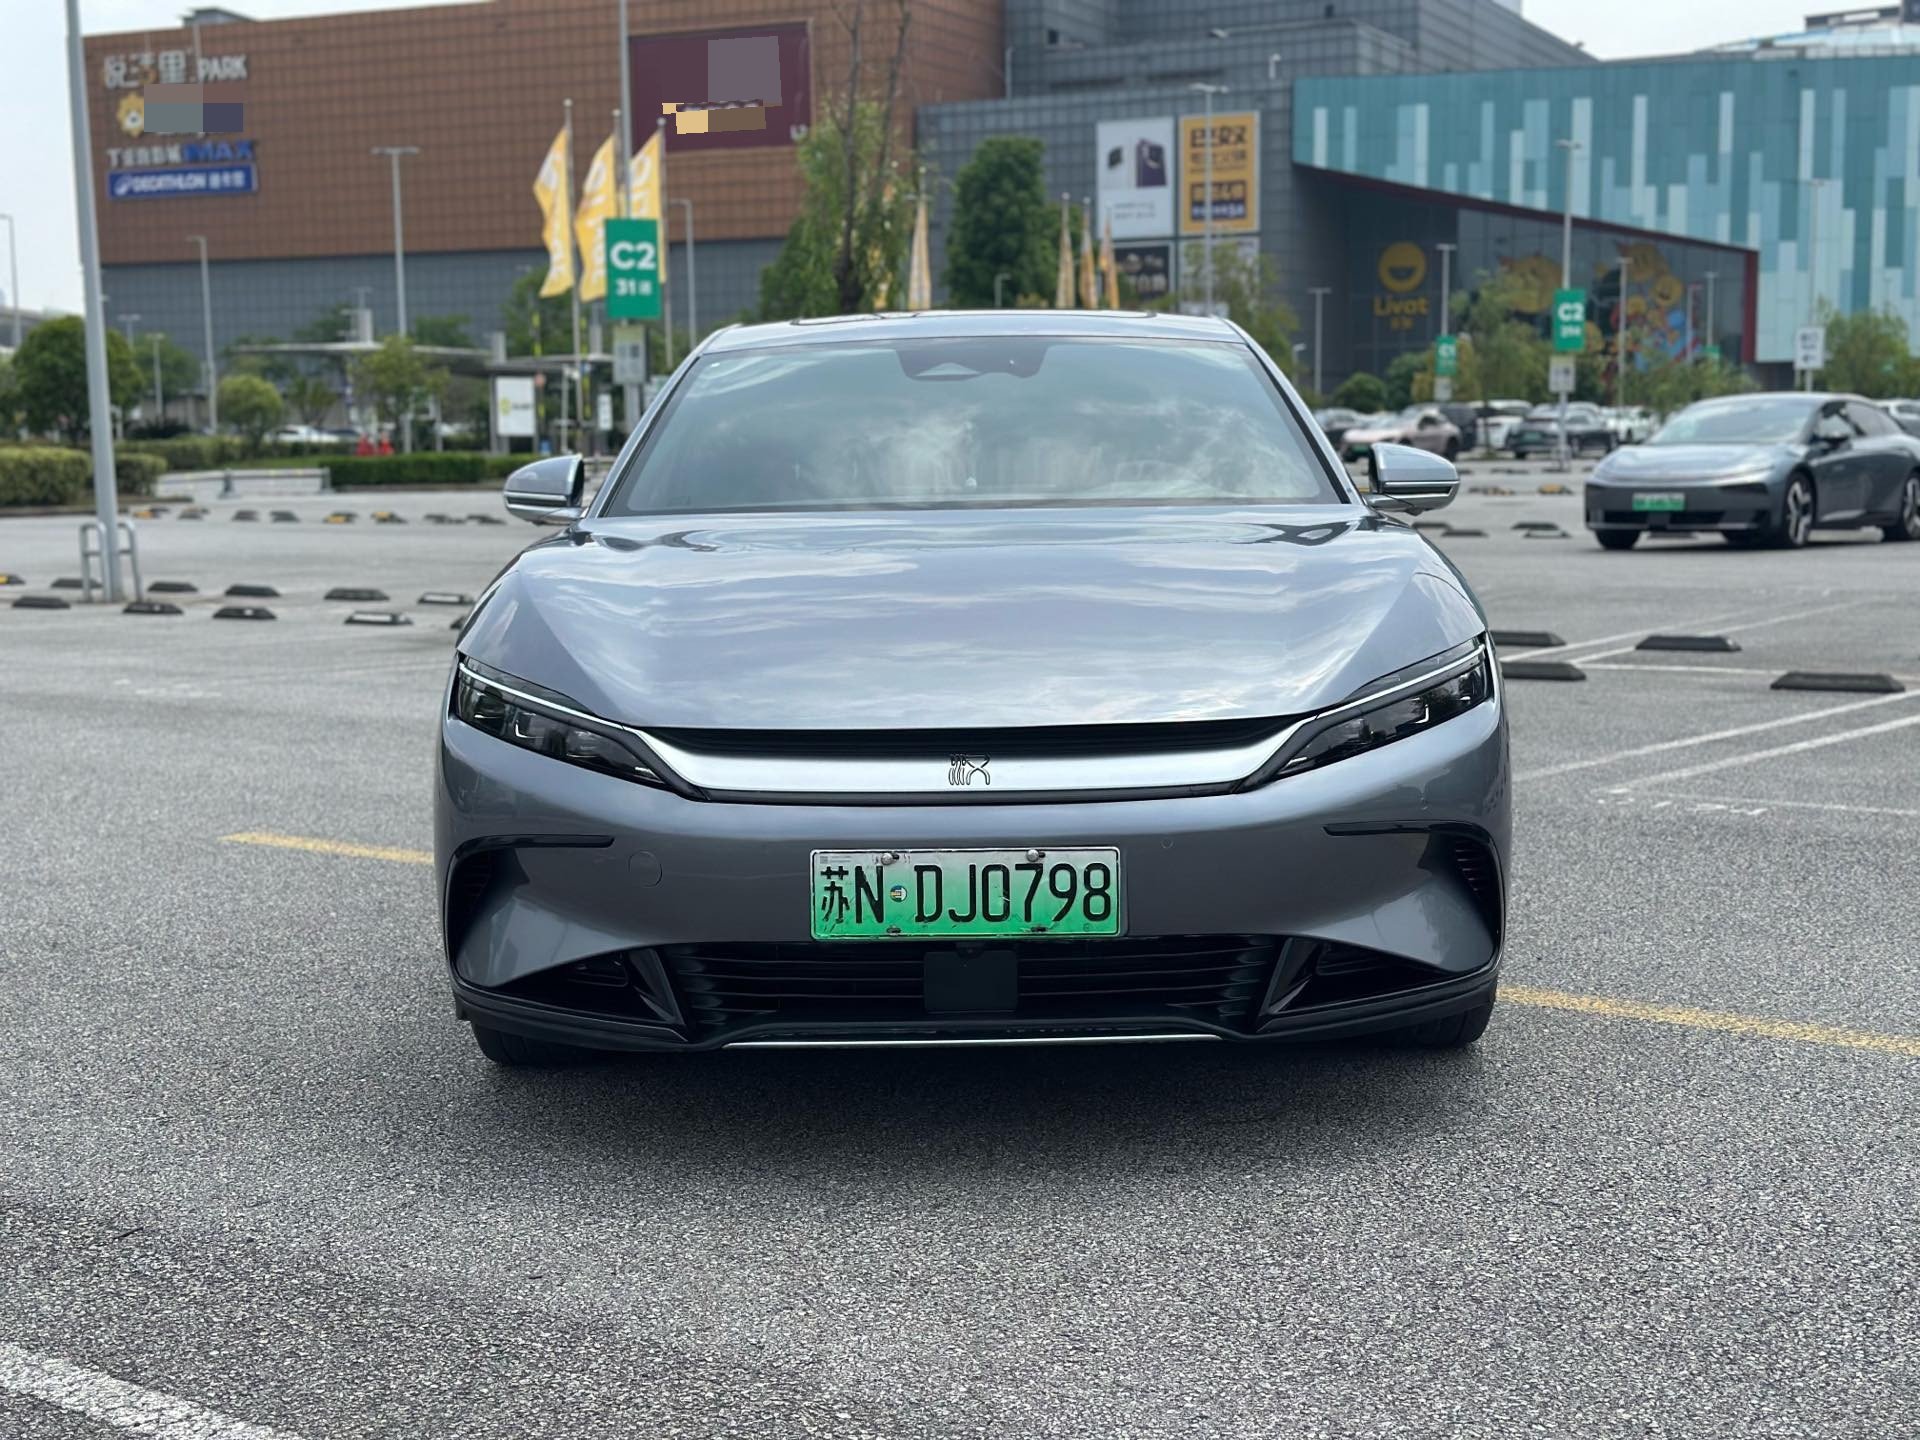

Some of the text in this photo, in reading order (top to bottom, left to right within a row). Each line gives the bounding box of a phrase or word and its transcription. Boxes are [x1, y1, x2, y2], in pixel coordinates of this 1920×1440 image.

[197, 53, 247, 82] PARK
[610, 241, 657, 270] C2
[1374, 296, 1428, 316] Livat
[1558, 302, 1585, 322] C2
